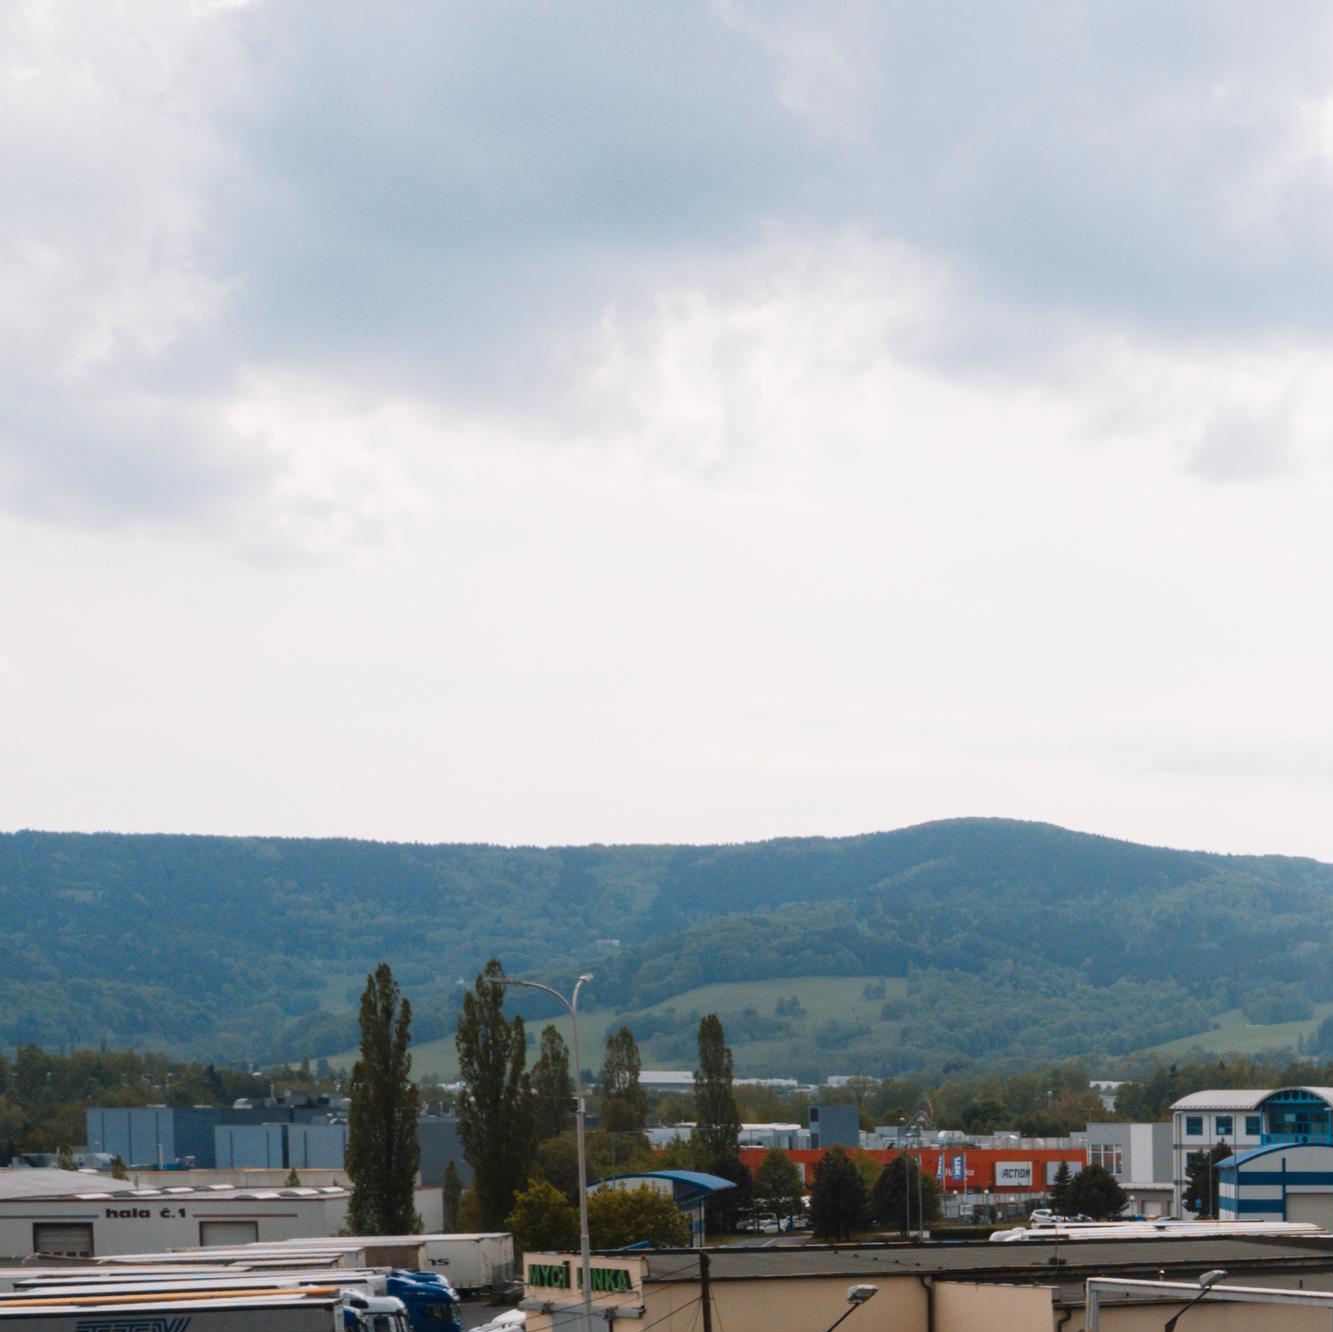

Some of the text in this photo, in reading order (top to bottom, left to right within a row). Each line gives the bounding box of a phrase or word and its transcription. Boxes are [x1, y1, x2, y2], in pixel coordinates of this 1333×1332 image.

[1002, 1168, 1030, 1179] ACTION
[105, 1207, 151, 1219] hala
[576, 1266, 633, 1291] LNKA
